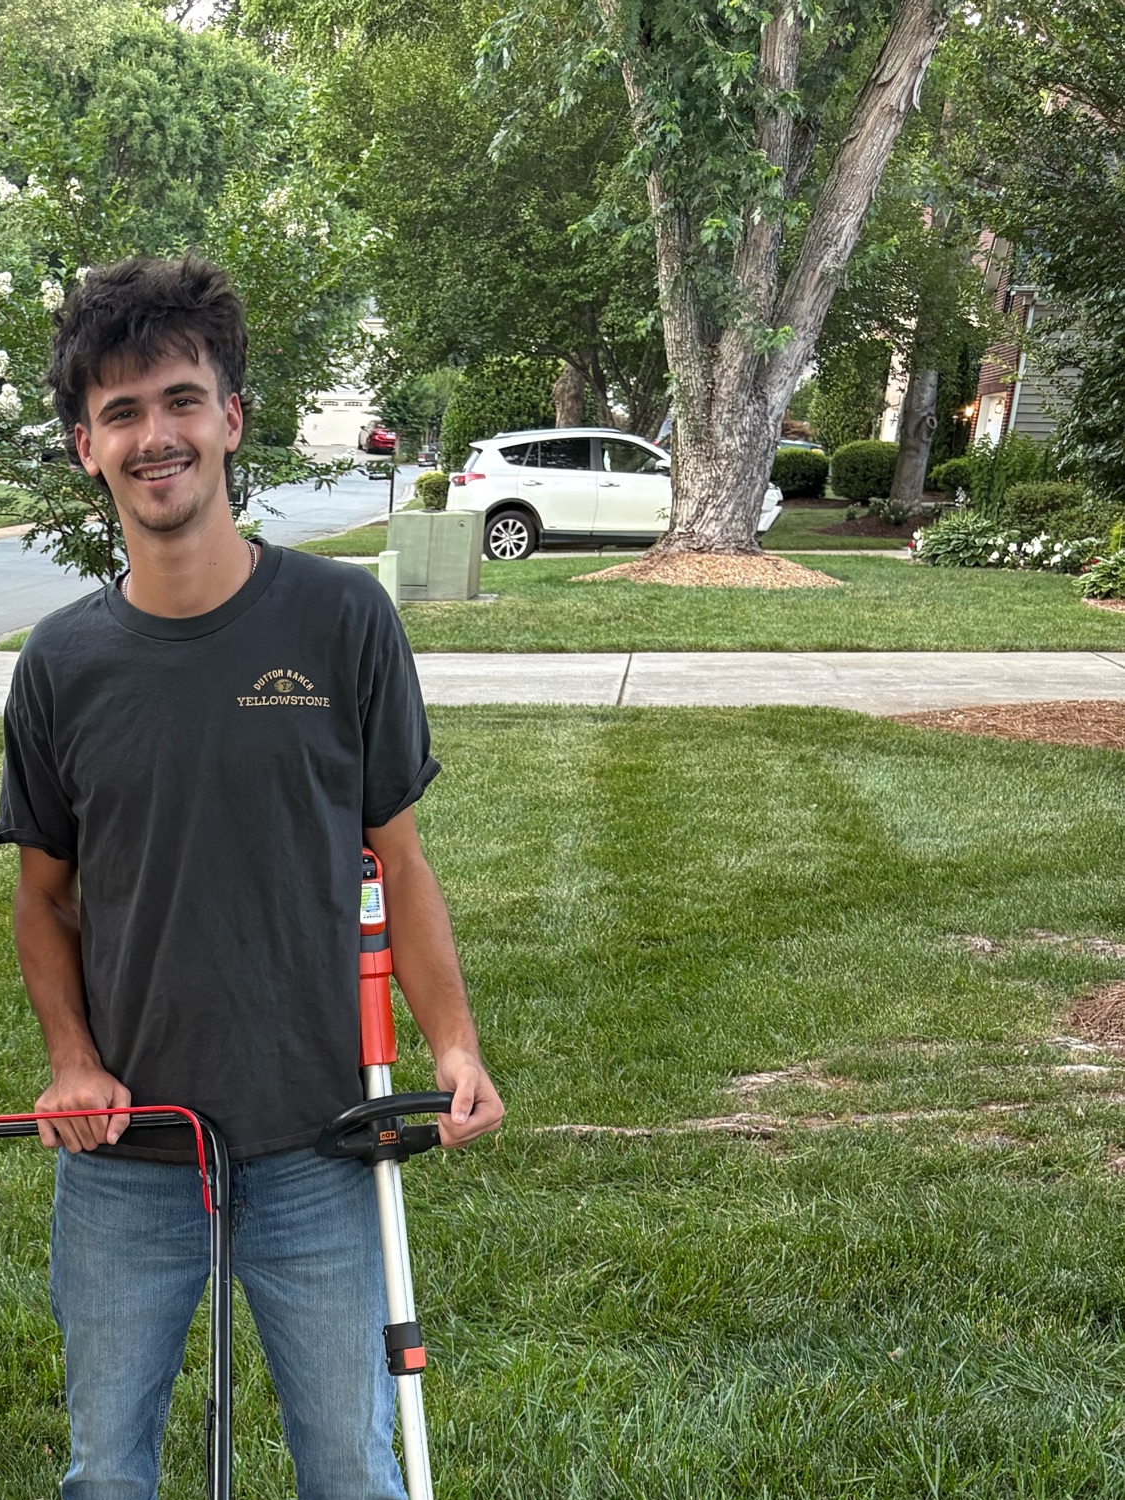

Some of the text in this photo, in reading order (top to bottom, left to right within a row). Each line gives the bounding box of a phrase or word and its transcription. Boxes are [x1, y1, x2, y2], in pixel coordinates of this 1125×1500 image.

[253, 668, 315, 691] DUTTON RANCH
[236, 695, 331, 708] YELLOWSTONE
